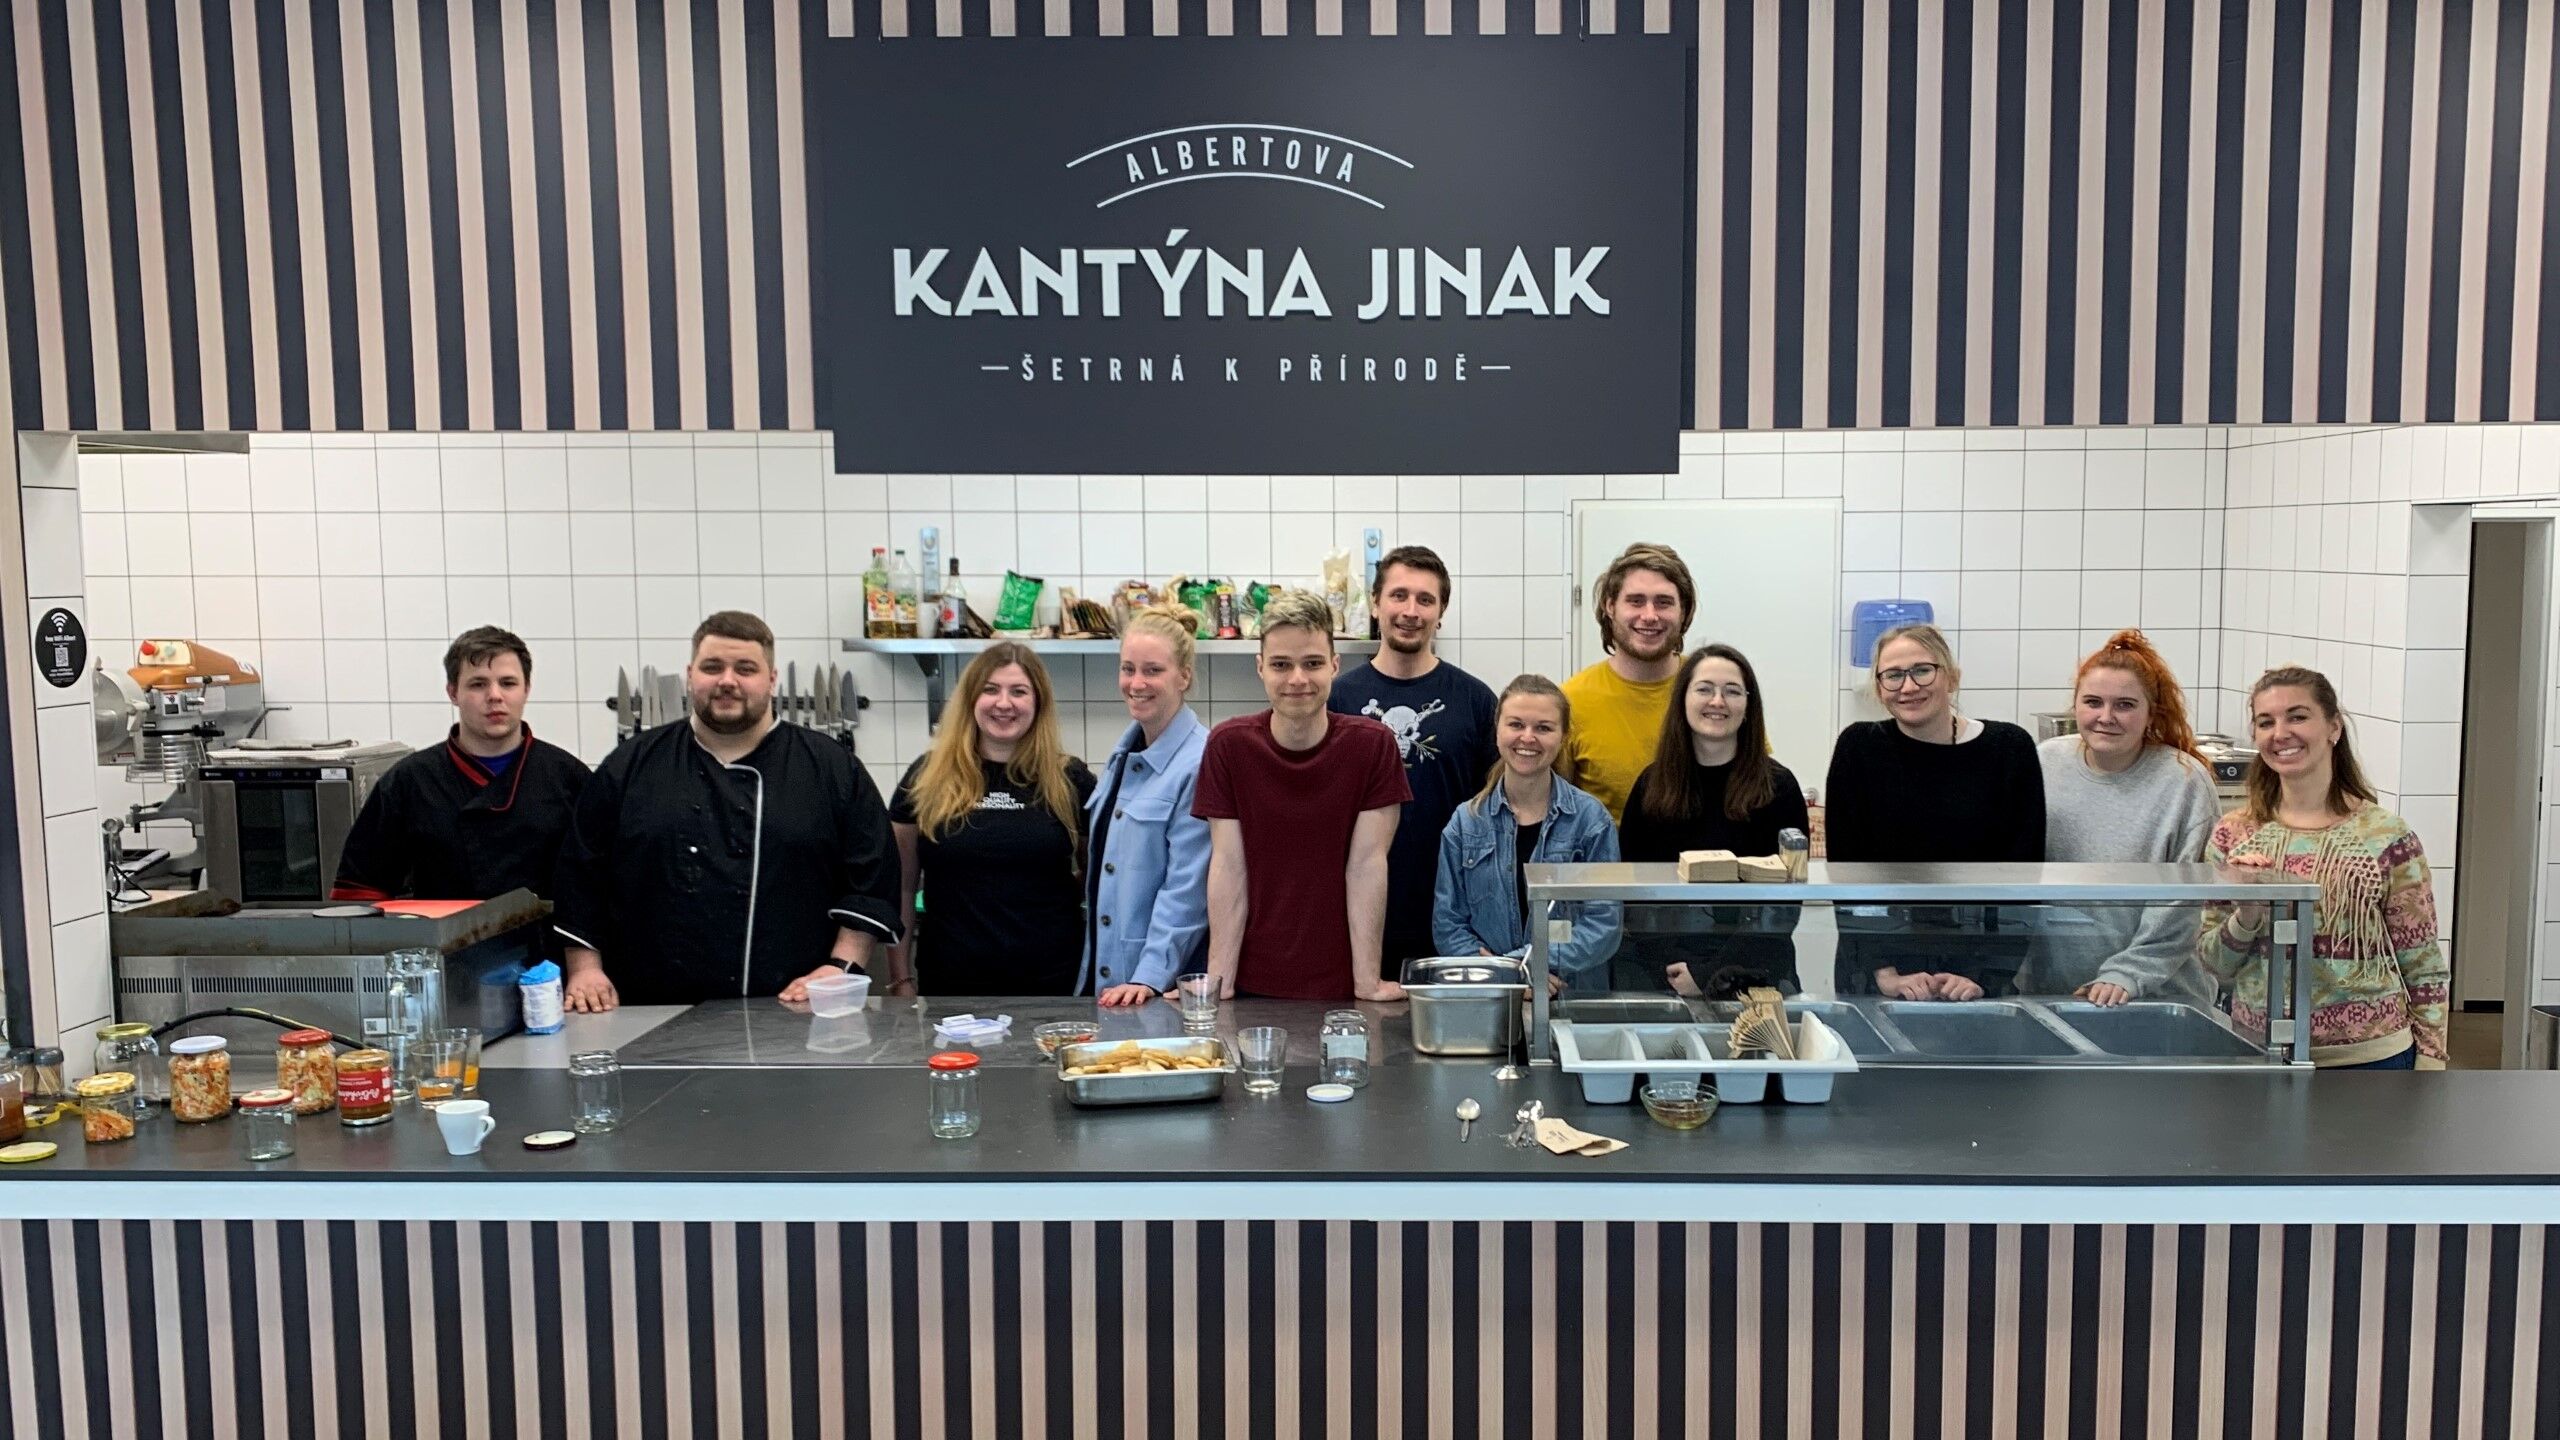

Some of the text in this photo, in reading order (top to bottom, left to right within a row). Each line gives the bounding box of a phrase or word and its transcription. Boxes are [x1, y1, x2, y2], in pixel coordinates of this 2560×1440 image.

[1126, 137, 1354, 182] ALBERTOVA
[894, 229, 1610, 319] KANTÝNA JINAK
[1022, 353, 1467, 382] ŠETRNÁ K PŘÍRODĚ
